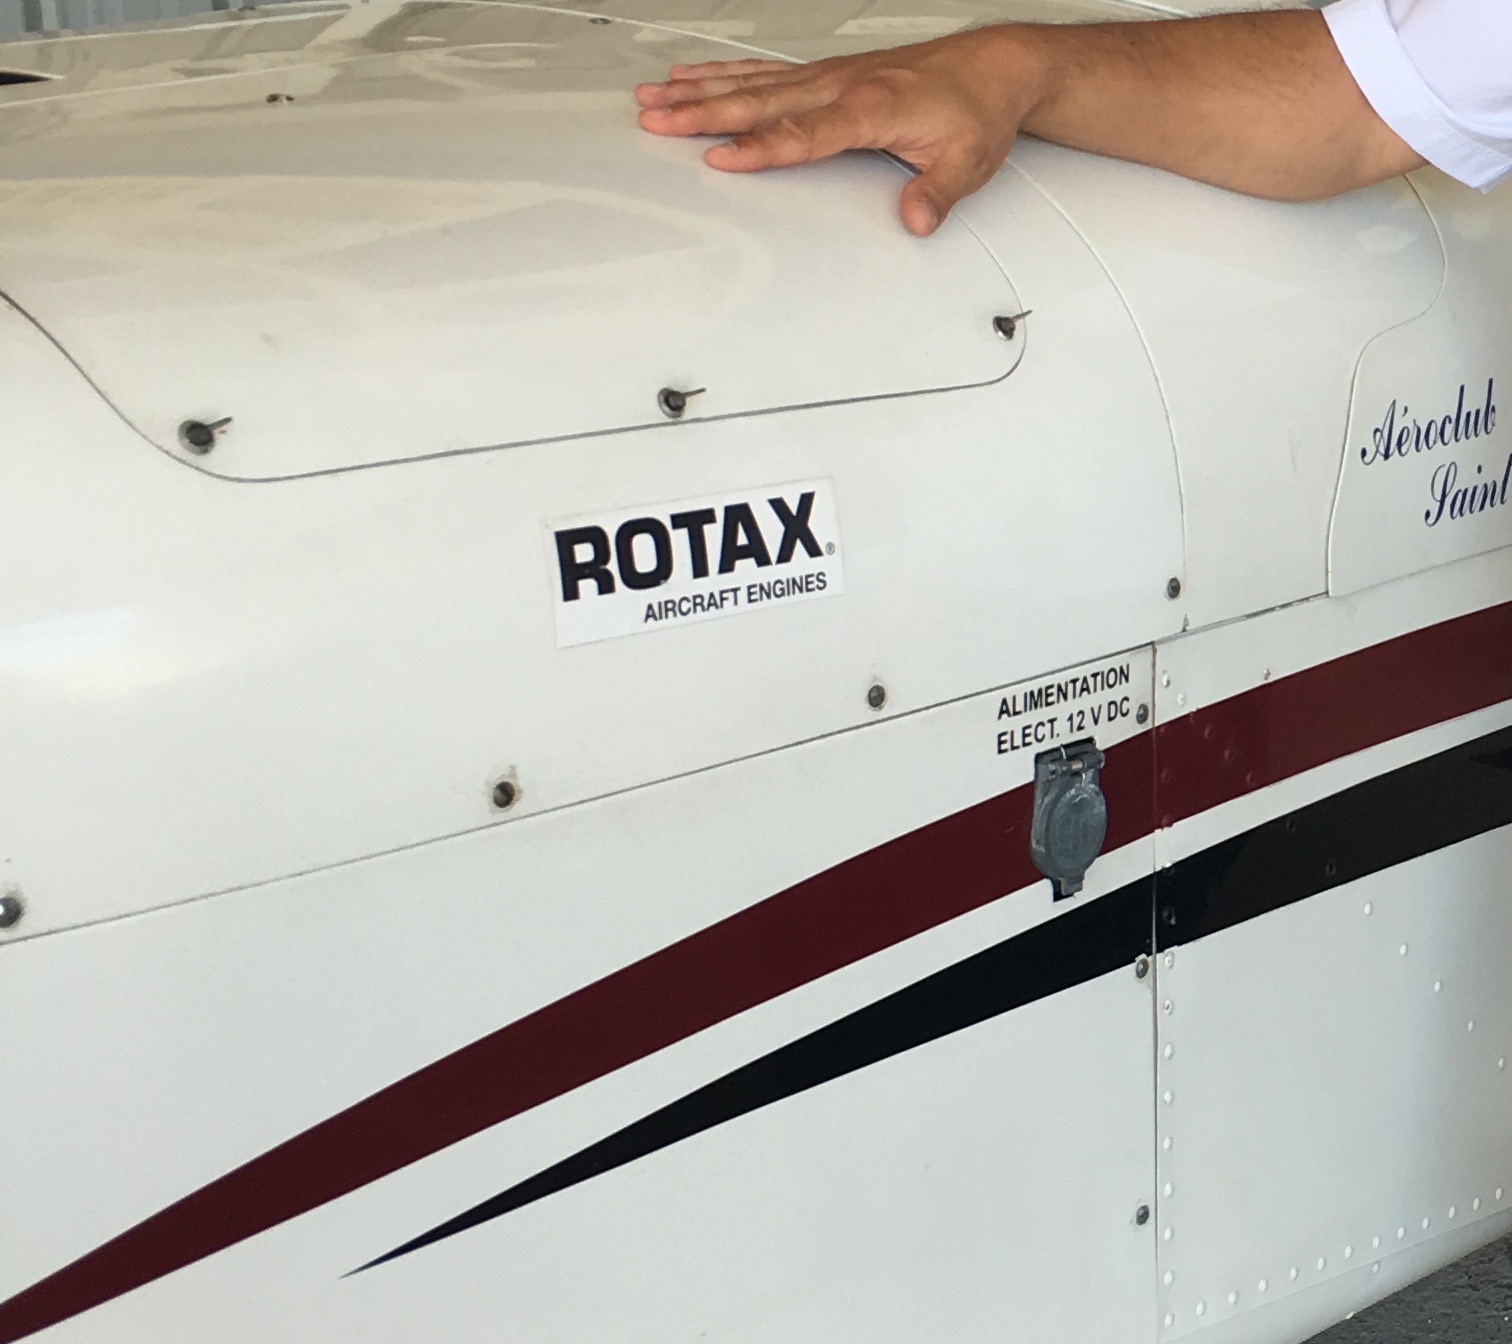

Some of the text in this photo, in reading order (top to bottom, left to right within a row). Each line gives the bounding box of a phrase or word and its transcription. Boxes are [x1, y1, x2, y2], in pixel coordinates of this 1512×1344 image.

[1360, 377, 1496, 466] Aéroclub
[554, 491, 824, 602] ROTAX
[644, 571, 827, 623] AIRCRAFT ENGINES
[997, 662, 1130, 721] ALIMENTATION
[997, 696, 1130, 755] ELECT. 12 V DC
